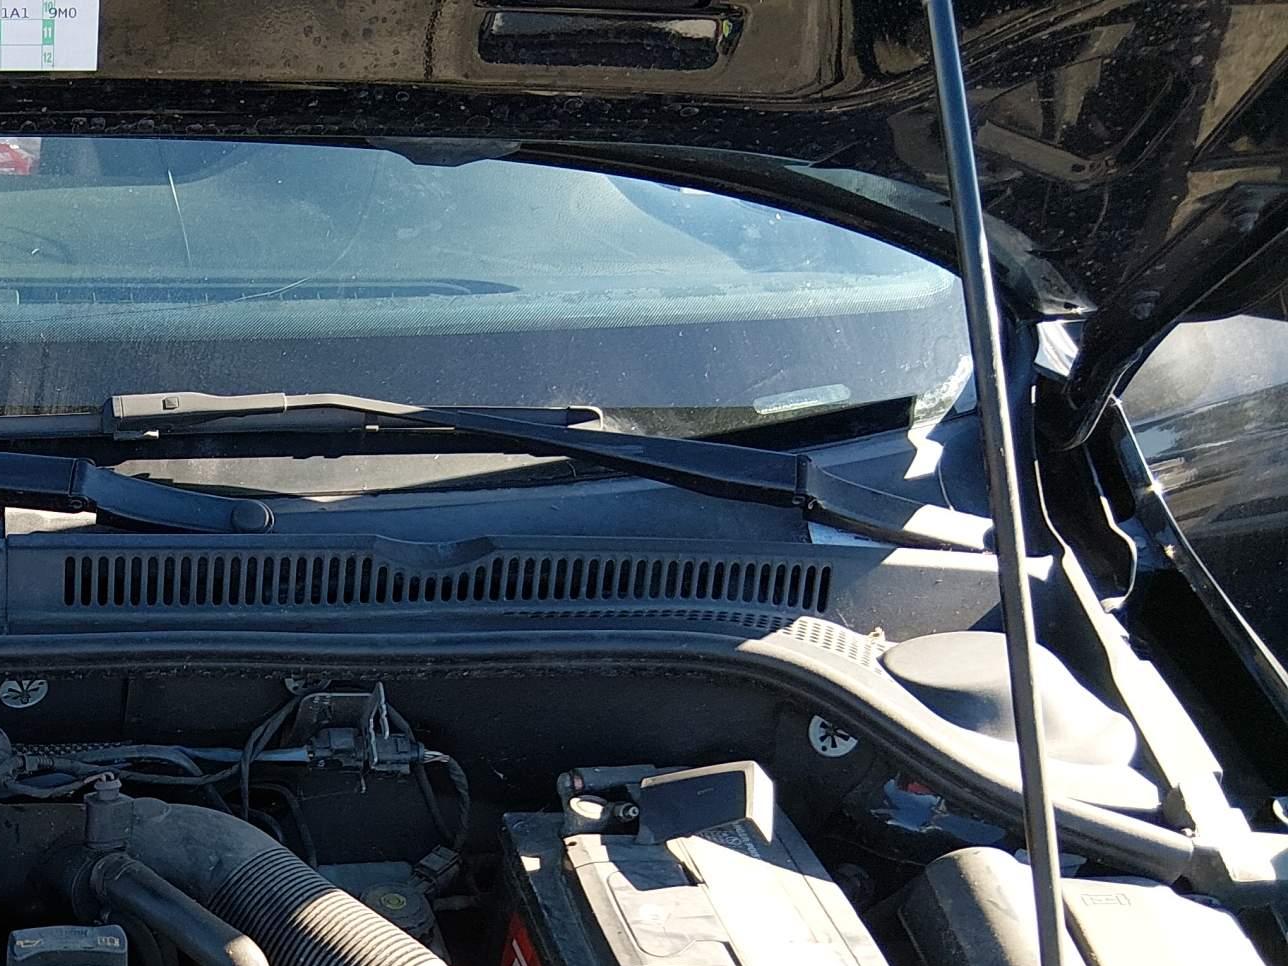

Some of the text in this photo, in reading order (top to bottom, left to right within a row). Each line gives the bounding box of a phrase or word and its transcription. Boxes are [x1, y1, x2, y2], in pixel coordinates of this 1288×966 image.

[2, 8, 30, 19] 1A1
[44, 27, 52, 38] 11
[44, 52, 52, 63] 12
